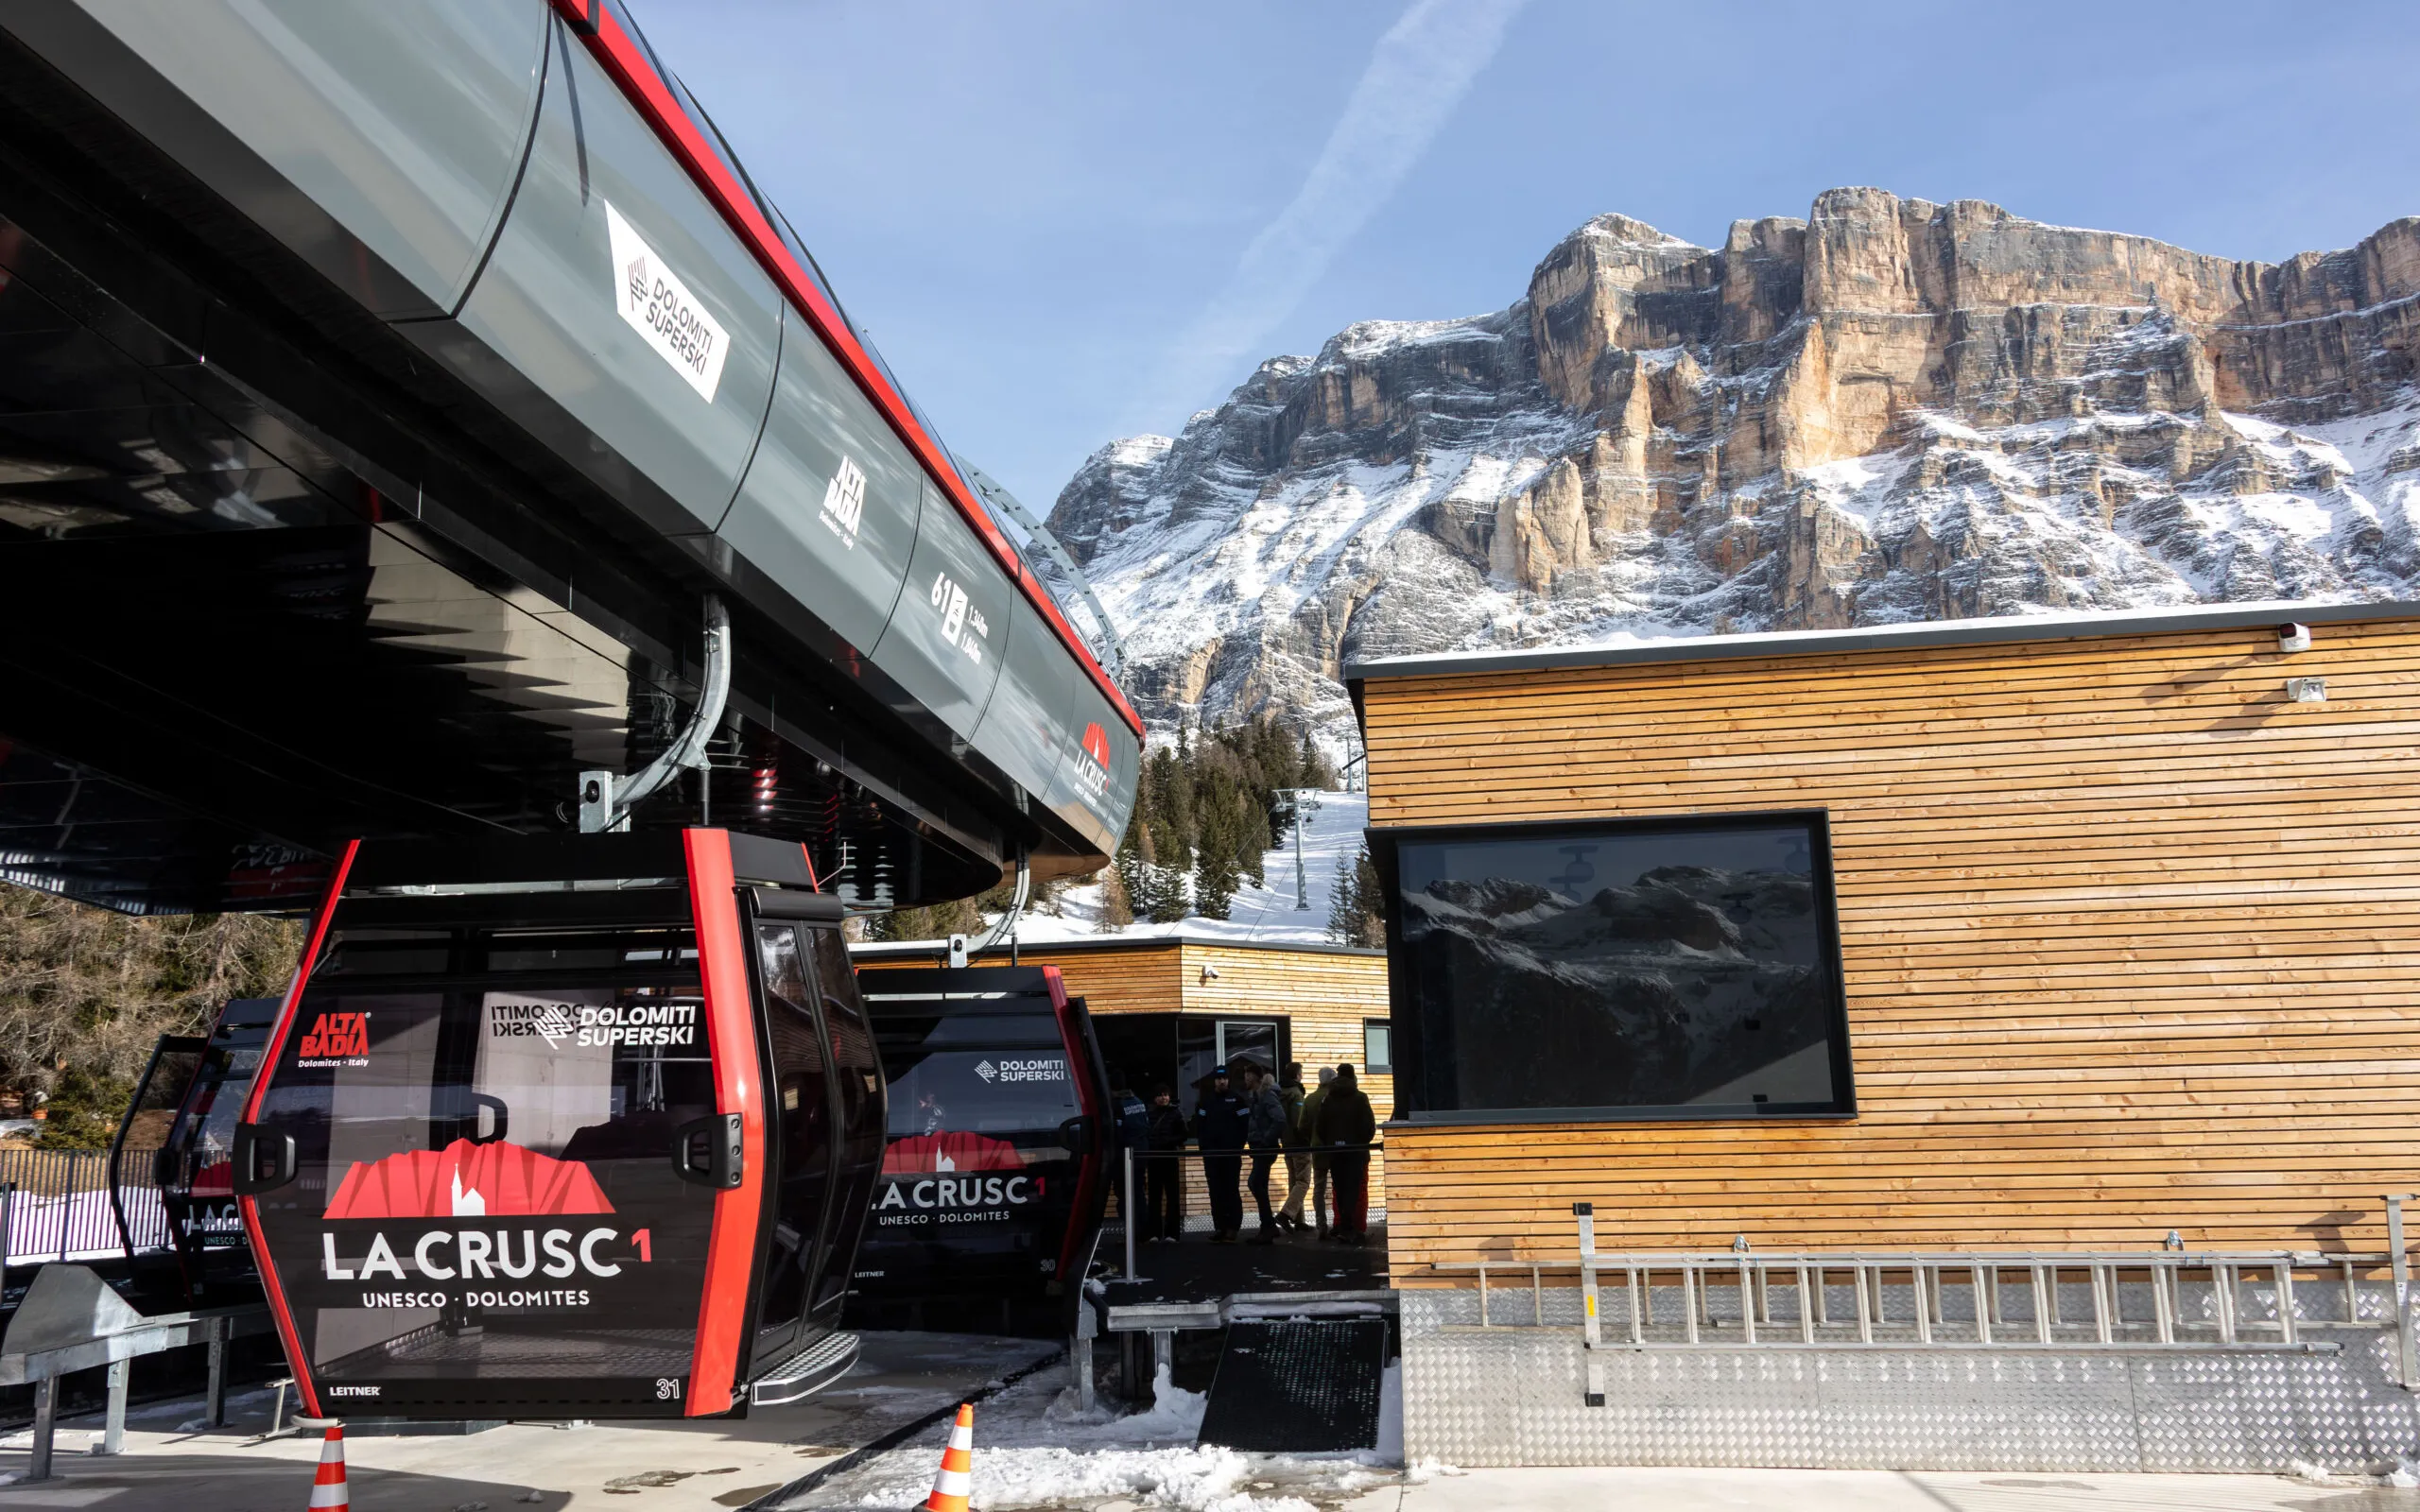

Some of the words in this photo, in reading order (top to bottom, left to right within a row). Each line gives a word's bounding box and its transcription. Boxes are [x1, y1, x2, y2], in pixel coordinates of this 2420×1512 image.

[653, 277, 713, 353] DOLOMITI
[646, 301, 707, 375] SUPERSKI
[931, 571, 952, 614] 61
[311, 1013, 367, 1035] ALTA
[580, 1006, 696, 1025] DOLOMITI
[300, 1034, 369, 1057] BADIA
[577, 1026, 694, 1046] SUPERSKI
[298, 1059, 340, 1068] Dolomites
[349, 1058, 369, 1067] Italy
[1000, 1059, 1063, 1071] DOLOMITI
[1000, 1071, 1064, 1081] SUPERSKI
[871, 1181, 907, 1211] A
[912, 1176, 1028, 1208] CRUSC
[1035, 1177, 1046, 1195] 1
[879, 1214, 928, 1226] UNESCO
[939, 1211, 1010, 1223] DOLOMITES
[204, 1236, 235, 1246] UNESCO
[414, 1228, 622, 1280] CRUSC
[631, 1228, 652, 1263] 1
[855, 1270, 886, 1279] LEITNER
[1040, 1258, 1056, 1272] 30
[362, 1292, 447, 1309] UNESCO
[466, 1290, 591, 1307] DOLOMITES
[329, 1386, 380, 1396] LEITNER
[656, 1378, 680, 1399] 31
